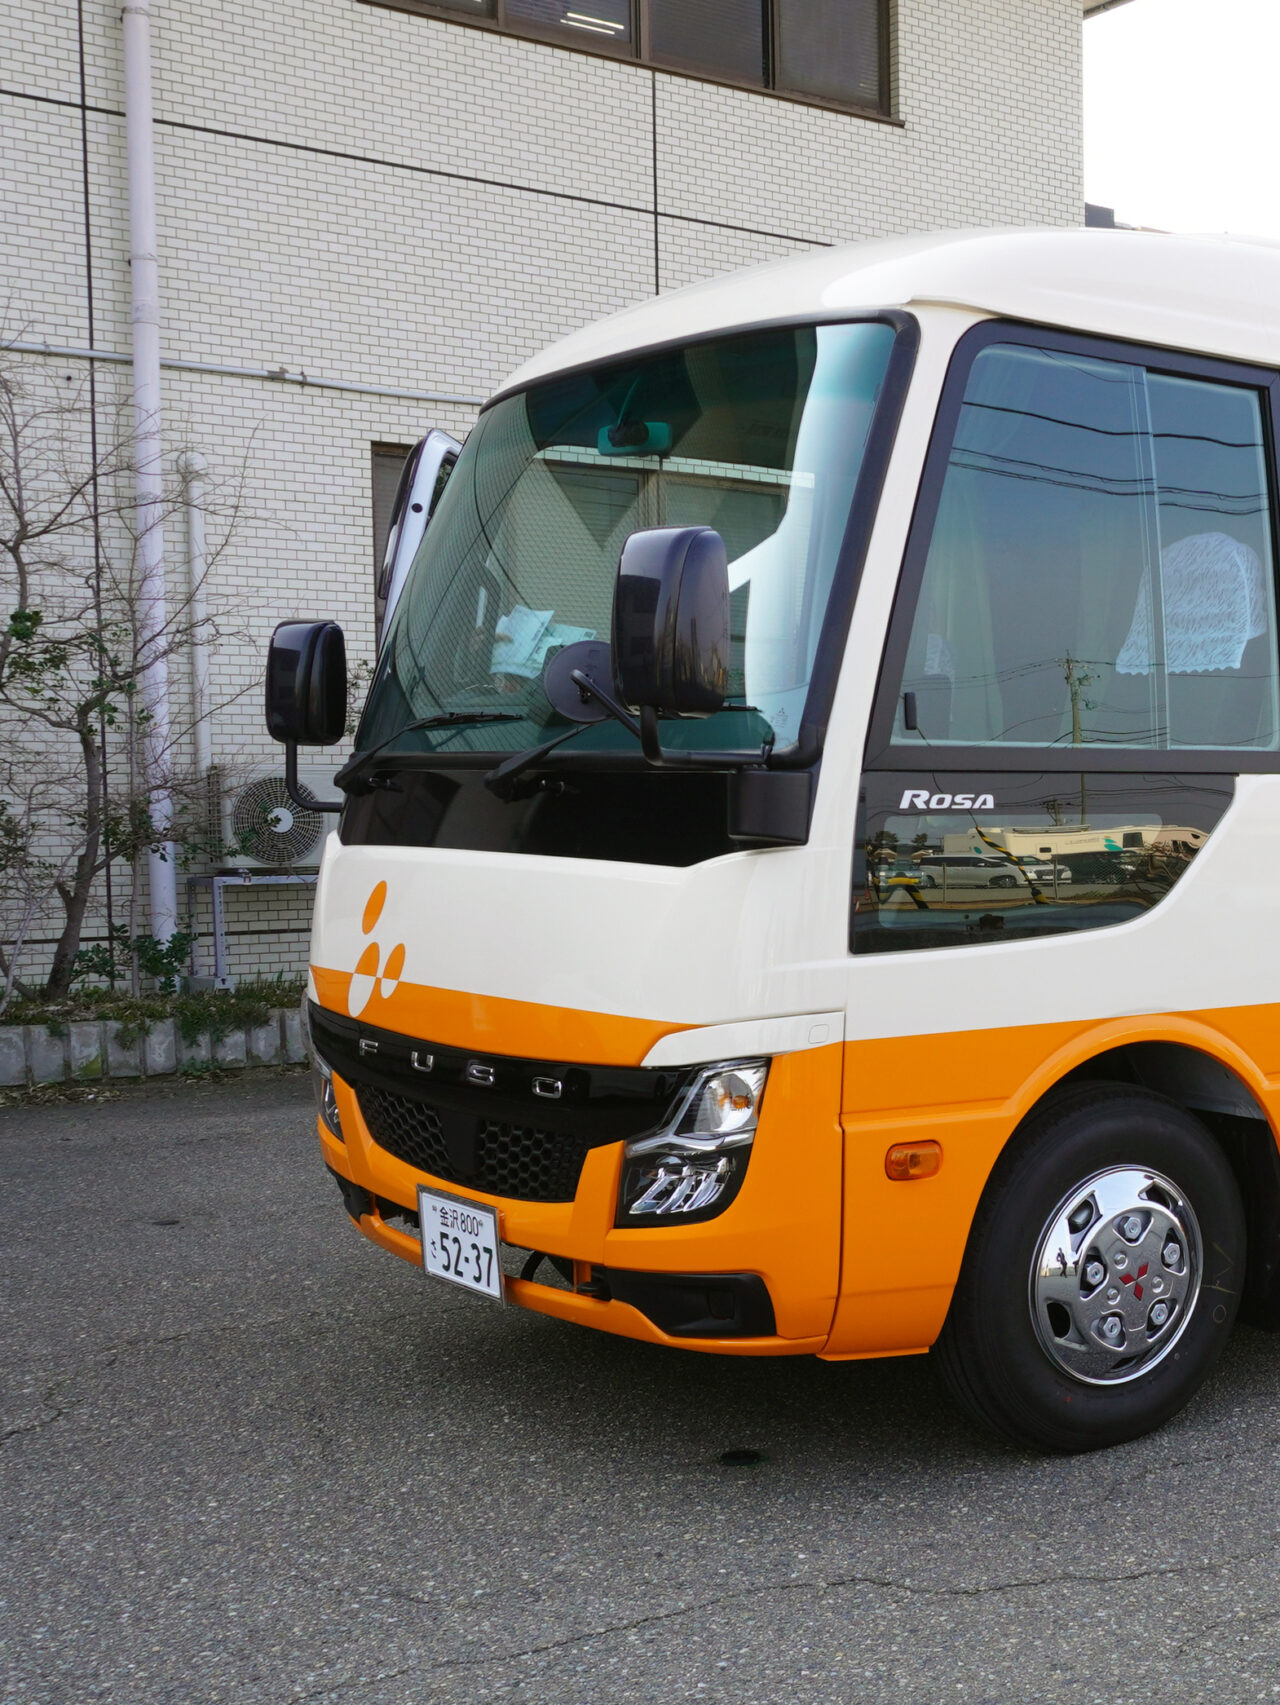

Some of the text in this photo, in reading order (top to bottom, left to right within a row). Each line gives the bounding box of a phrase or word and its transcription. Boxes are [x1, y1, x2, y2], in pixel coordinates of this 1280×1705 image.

[899, 789, 995, 810] ROSA
[359, 1038, 563, 1099] FUSO
[440, 1231, 493, 1288] 52-37
